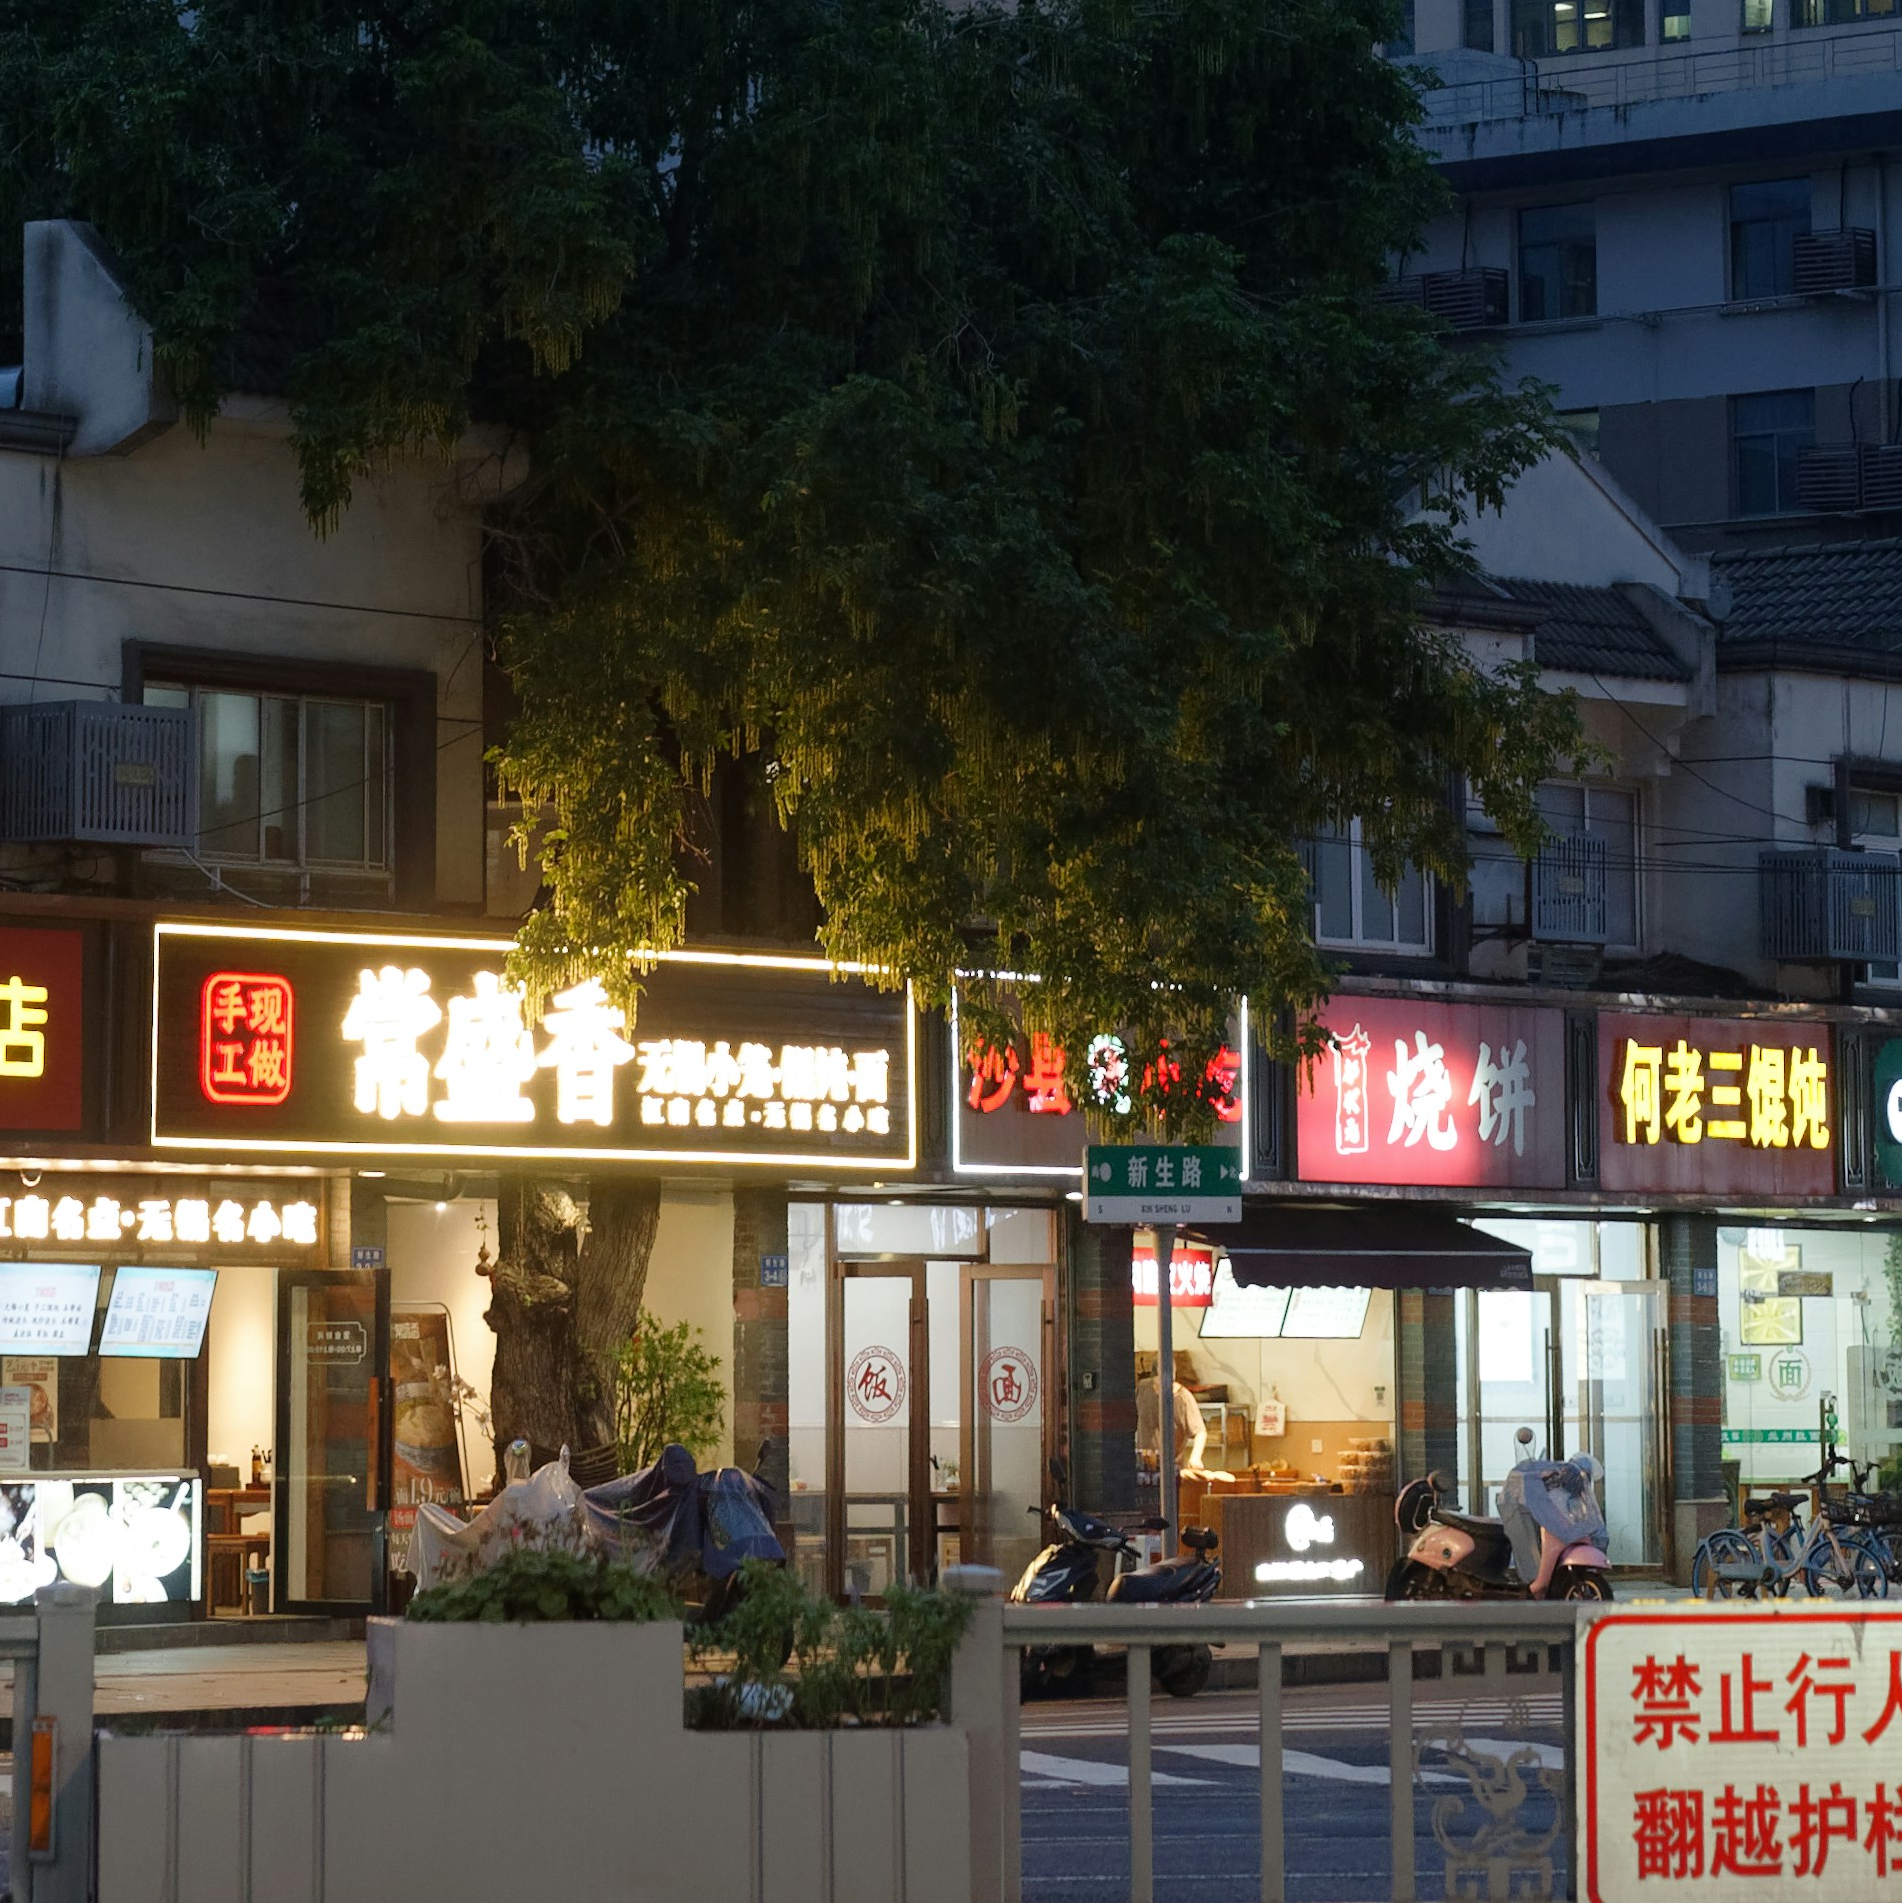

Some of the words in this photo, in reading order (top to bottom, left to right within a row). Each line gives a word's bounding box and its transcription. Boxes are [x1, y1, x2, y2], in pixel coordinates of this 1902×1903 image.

[1387, 1029, 1535, 1157] 烧饼
[1620, 1037, 1832, 1152] 何老三馄饨
[1128, 1155, 1202, 1188] 新生路
[1155, 1204, 1178, 1214] SHENG
[857, 1362, 893, 1404] 饭
[990, 1363, 1024, 1406] 面
[1778, 1359, 1802, 1389] 面
